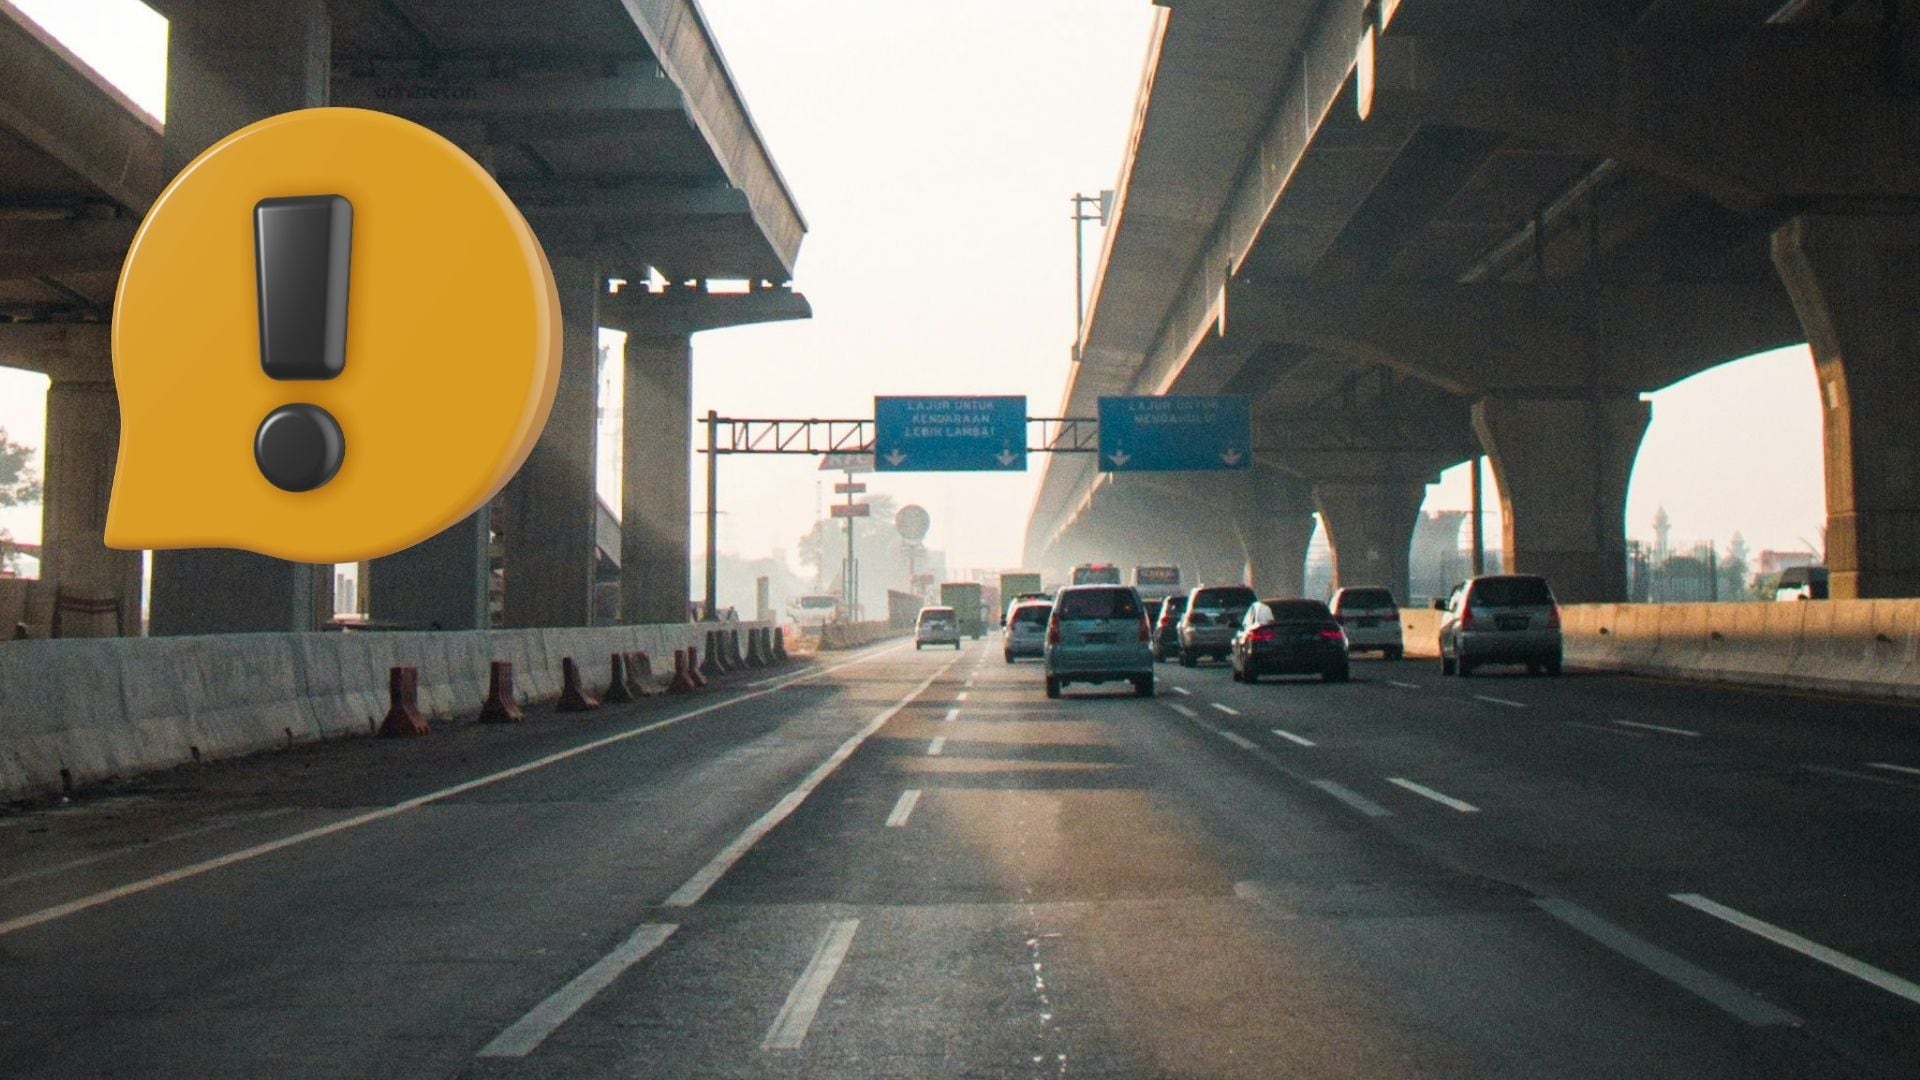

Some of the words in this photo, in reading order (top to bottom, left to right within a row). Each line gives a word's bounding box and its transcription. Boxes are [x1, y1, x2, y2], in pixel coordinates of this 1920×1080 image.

[907, 400, 950, 410] LAJUR
[954, 400, 994, 410] UNTUK
[911, 413, 990, 424] KENDARAAN
